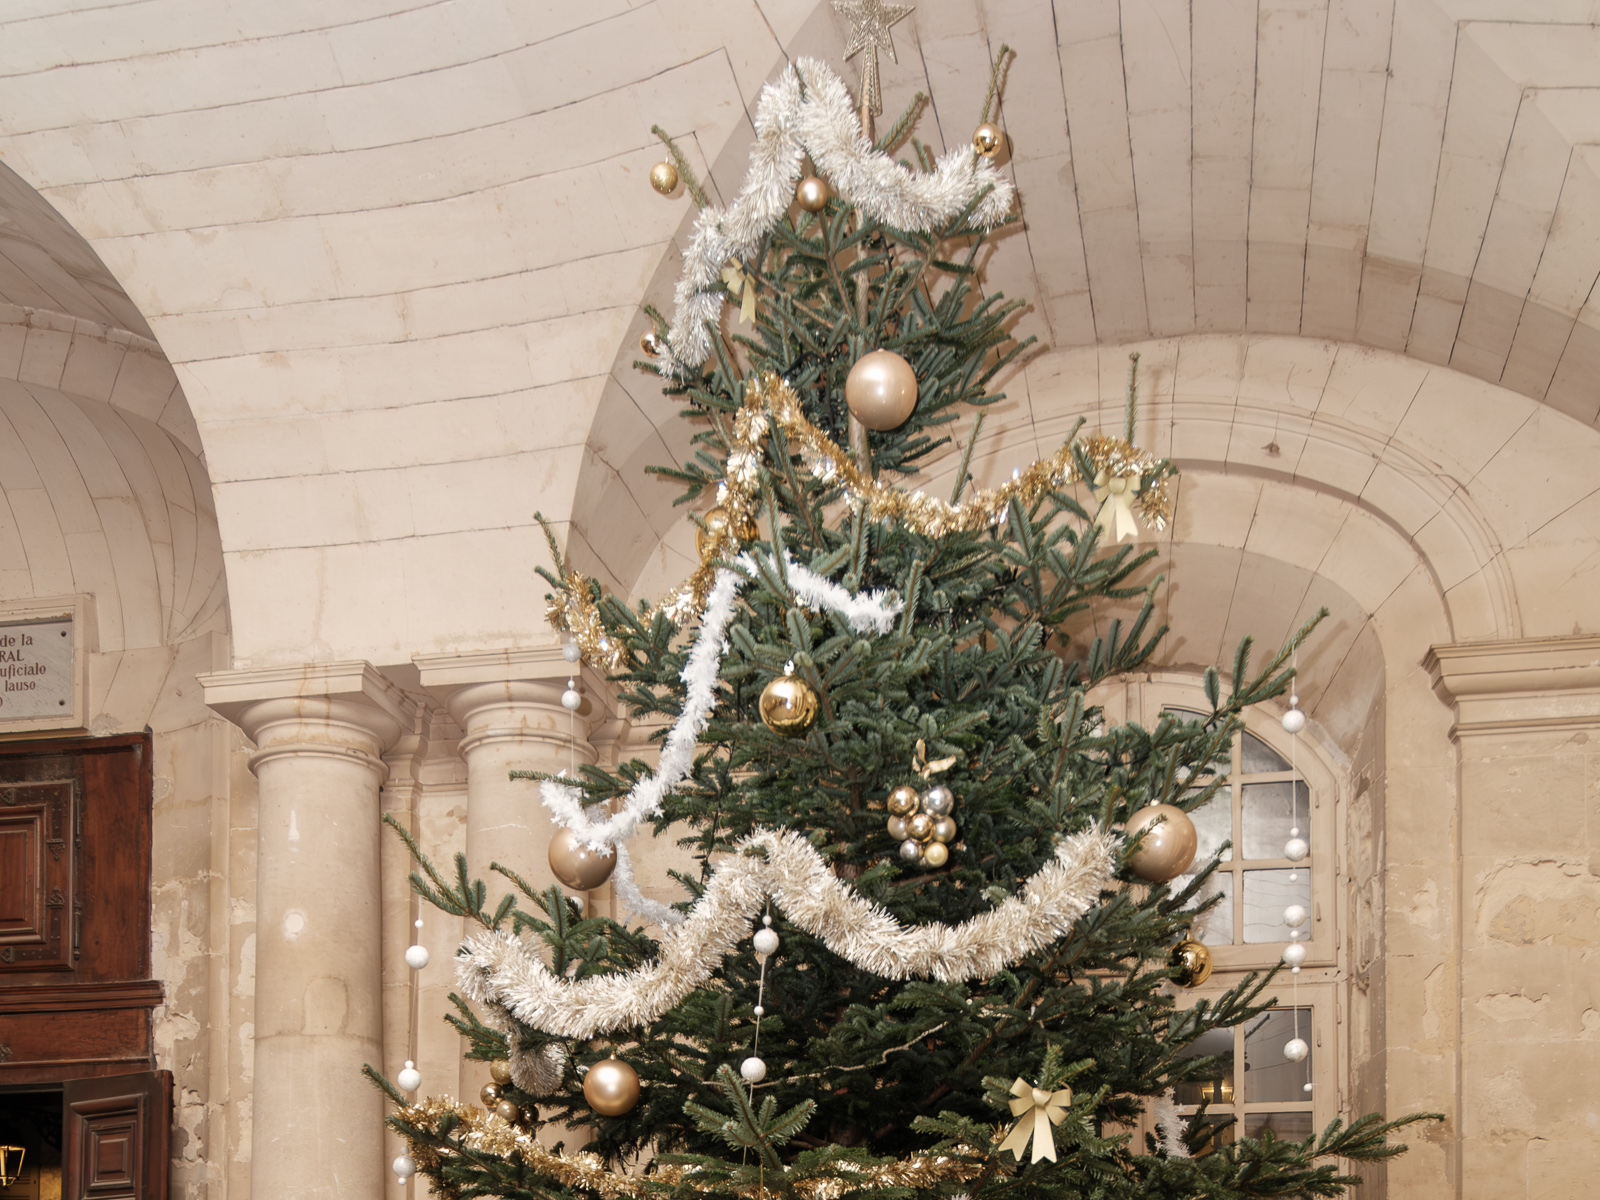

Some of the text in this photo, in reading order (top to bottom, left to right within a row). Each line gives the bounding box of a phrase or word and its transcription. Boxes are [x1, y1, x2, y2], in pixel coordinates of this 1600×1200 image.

[0, 634, 33, 647] de la
[5, 680, 36, 692] lauso
